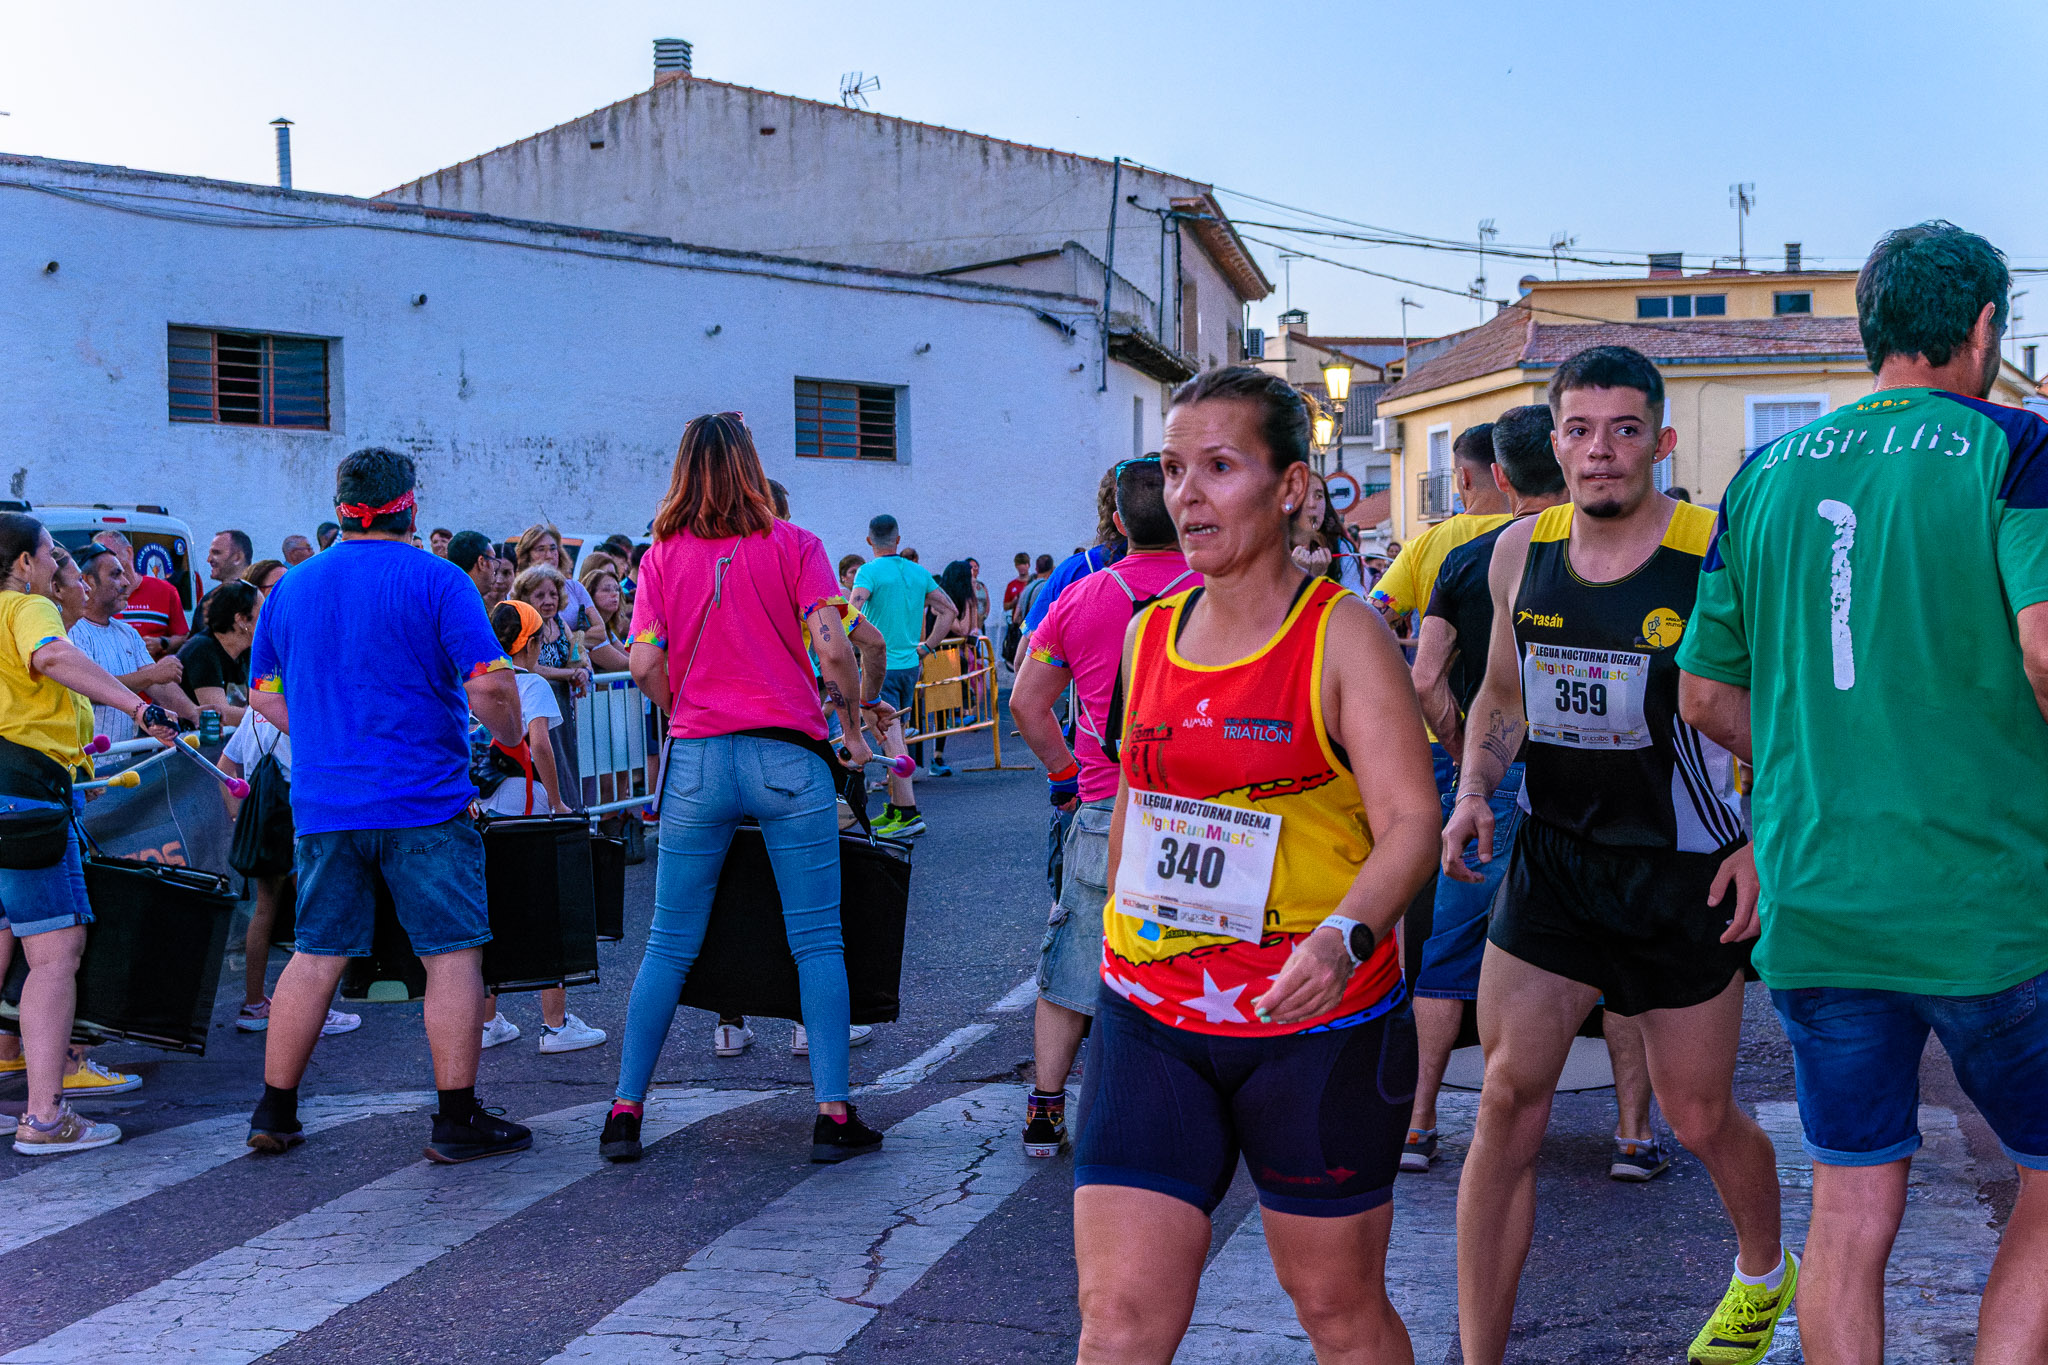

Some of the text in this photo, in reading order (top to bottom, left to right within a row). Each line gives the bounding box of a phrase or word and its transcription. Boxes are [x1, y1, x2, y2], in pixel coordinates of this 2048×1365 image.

[1817, 498, 1857, 691] 1
[1536, 646, 1560, 659] LEGUA
[1561, 648, 1609, 664] NOCTURNA
[1610, 653, 1642, 667] UGENA
[1555, 679, 1608, 717] 359
[1143, 794, 1172, 811] LEGUA
[1173, 799, 1232, 822] NOCTURNA
[1233, 811, 1272, 830] UGENA
[1157, 837, 1226, 889] 340
